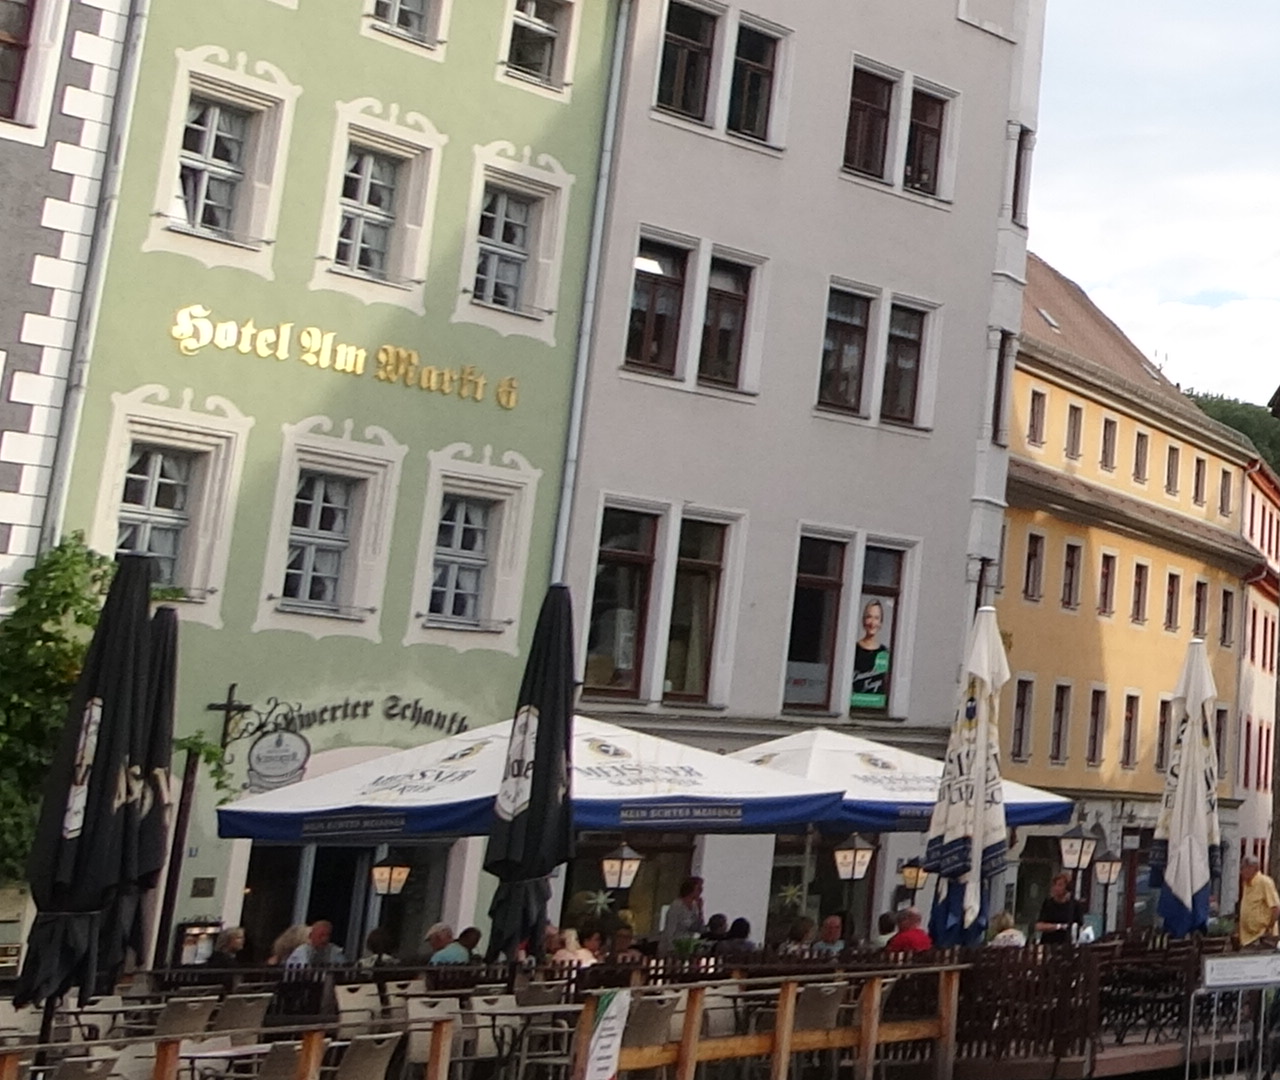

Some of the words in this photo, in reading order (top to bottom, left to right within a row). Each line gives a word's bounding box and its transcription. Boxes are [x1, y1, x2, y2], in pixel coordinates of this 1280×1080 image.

[172, 304, 295, 361] Hotel
[300, 327, 367, 375] Am
[375, 344, 488, 403] Markt
[497, 376, 519, 409] 6
